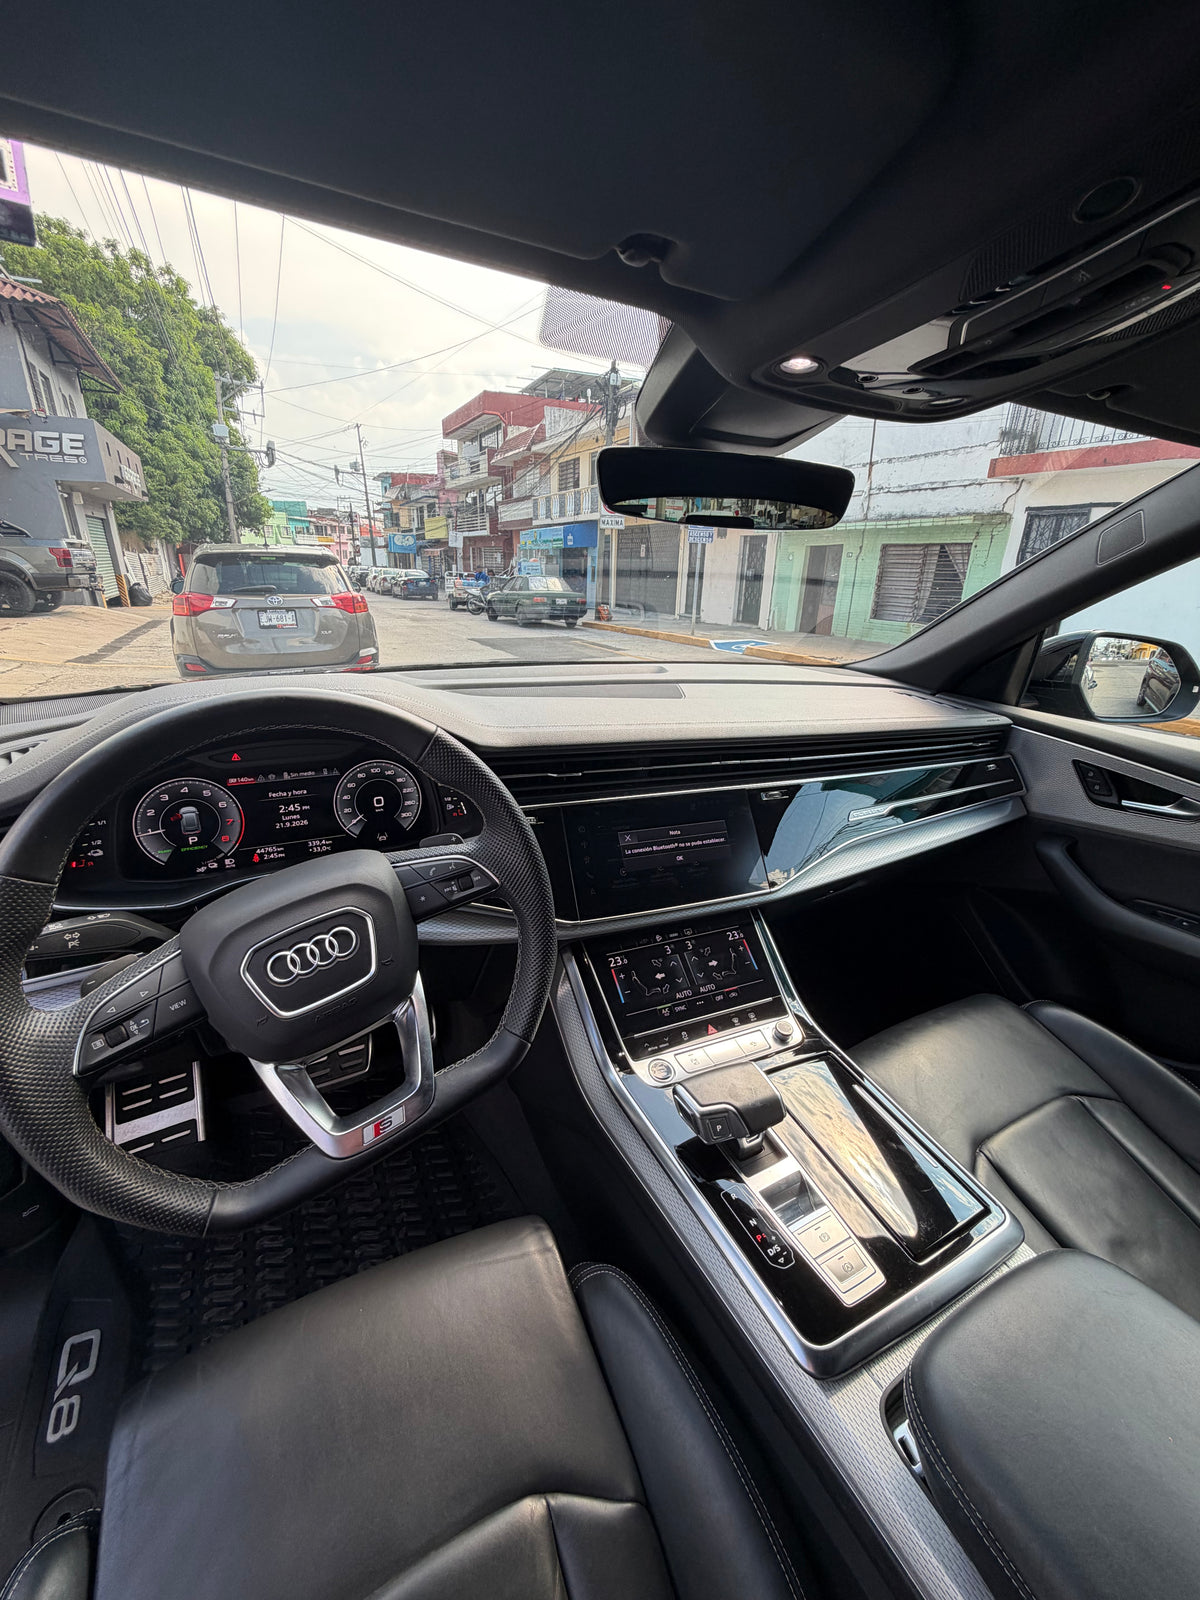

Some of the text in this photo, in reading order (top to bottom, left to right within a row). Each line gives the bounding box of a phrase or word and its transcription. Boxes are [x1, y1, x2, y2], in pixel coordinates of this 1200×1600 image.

[19, 452, 79, 464] TRES
[202, 789, 212, 797] 5
[279, 803, 301, 813] 2:45
[275, 819, 309, 829] 21.9.2026
[188, 836, 198, 845] P
[181, 844, 208, 852] EFFICIENCY
[632, 846, 653, 854] conexión
[663, 945, 671, 955] 3
[685, 941, 693, 950] 3
[700, 983, 716, 993] AUTO
[675, 989, 693, 999] AUTO
[169, 999, 187, 1011] VIEW
[674, 1004, 687, 1013] SYNC
[129, 1023, 139, 1032] OK
[716, 1124, 722, 1132] P
[730, 1192, 738, 1200] R
[749, 1218, 758, 1227] N
[767, 1244, 781, 1257] D/S
[46, 1328, 101, 1444] Q8
